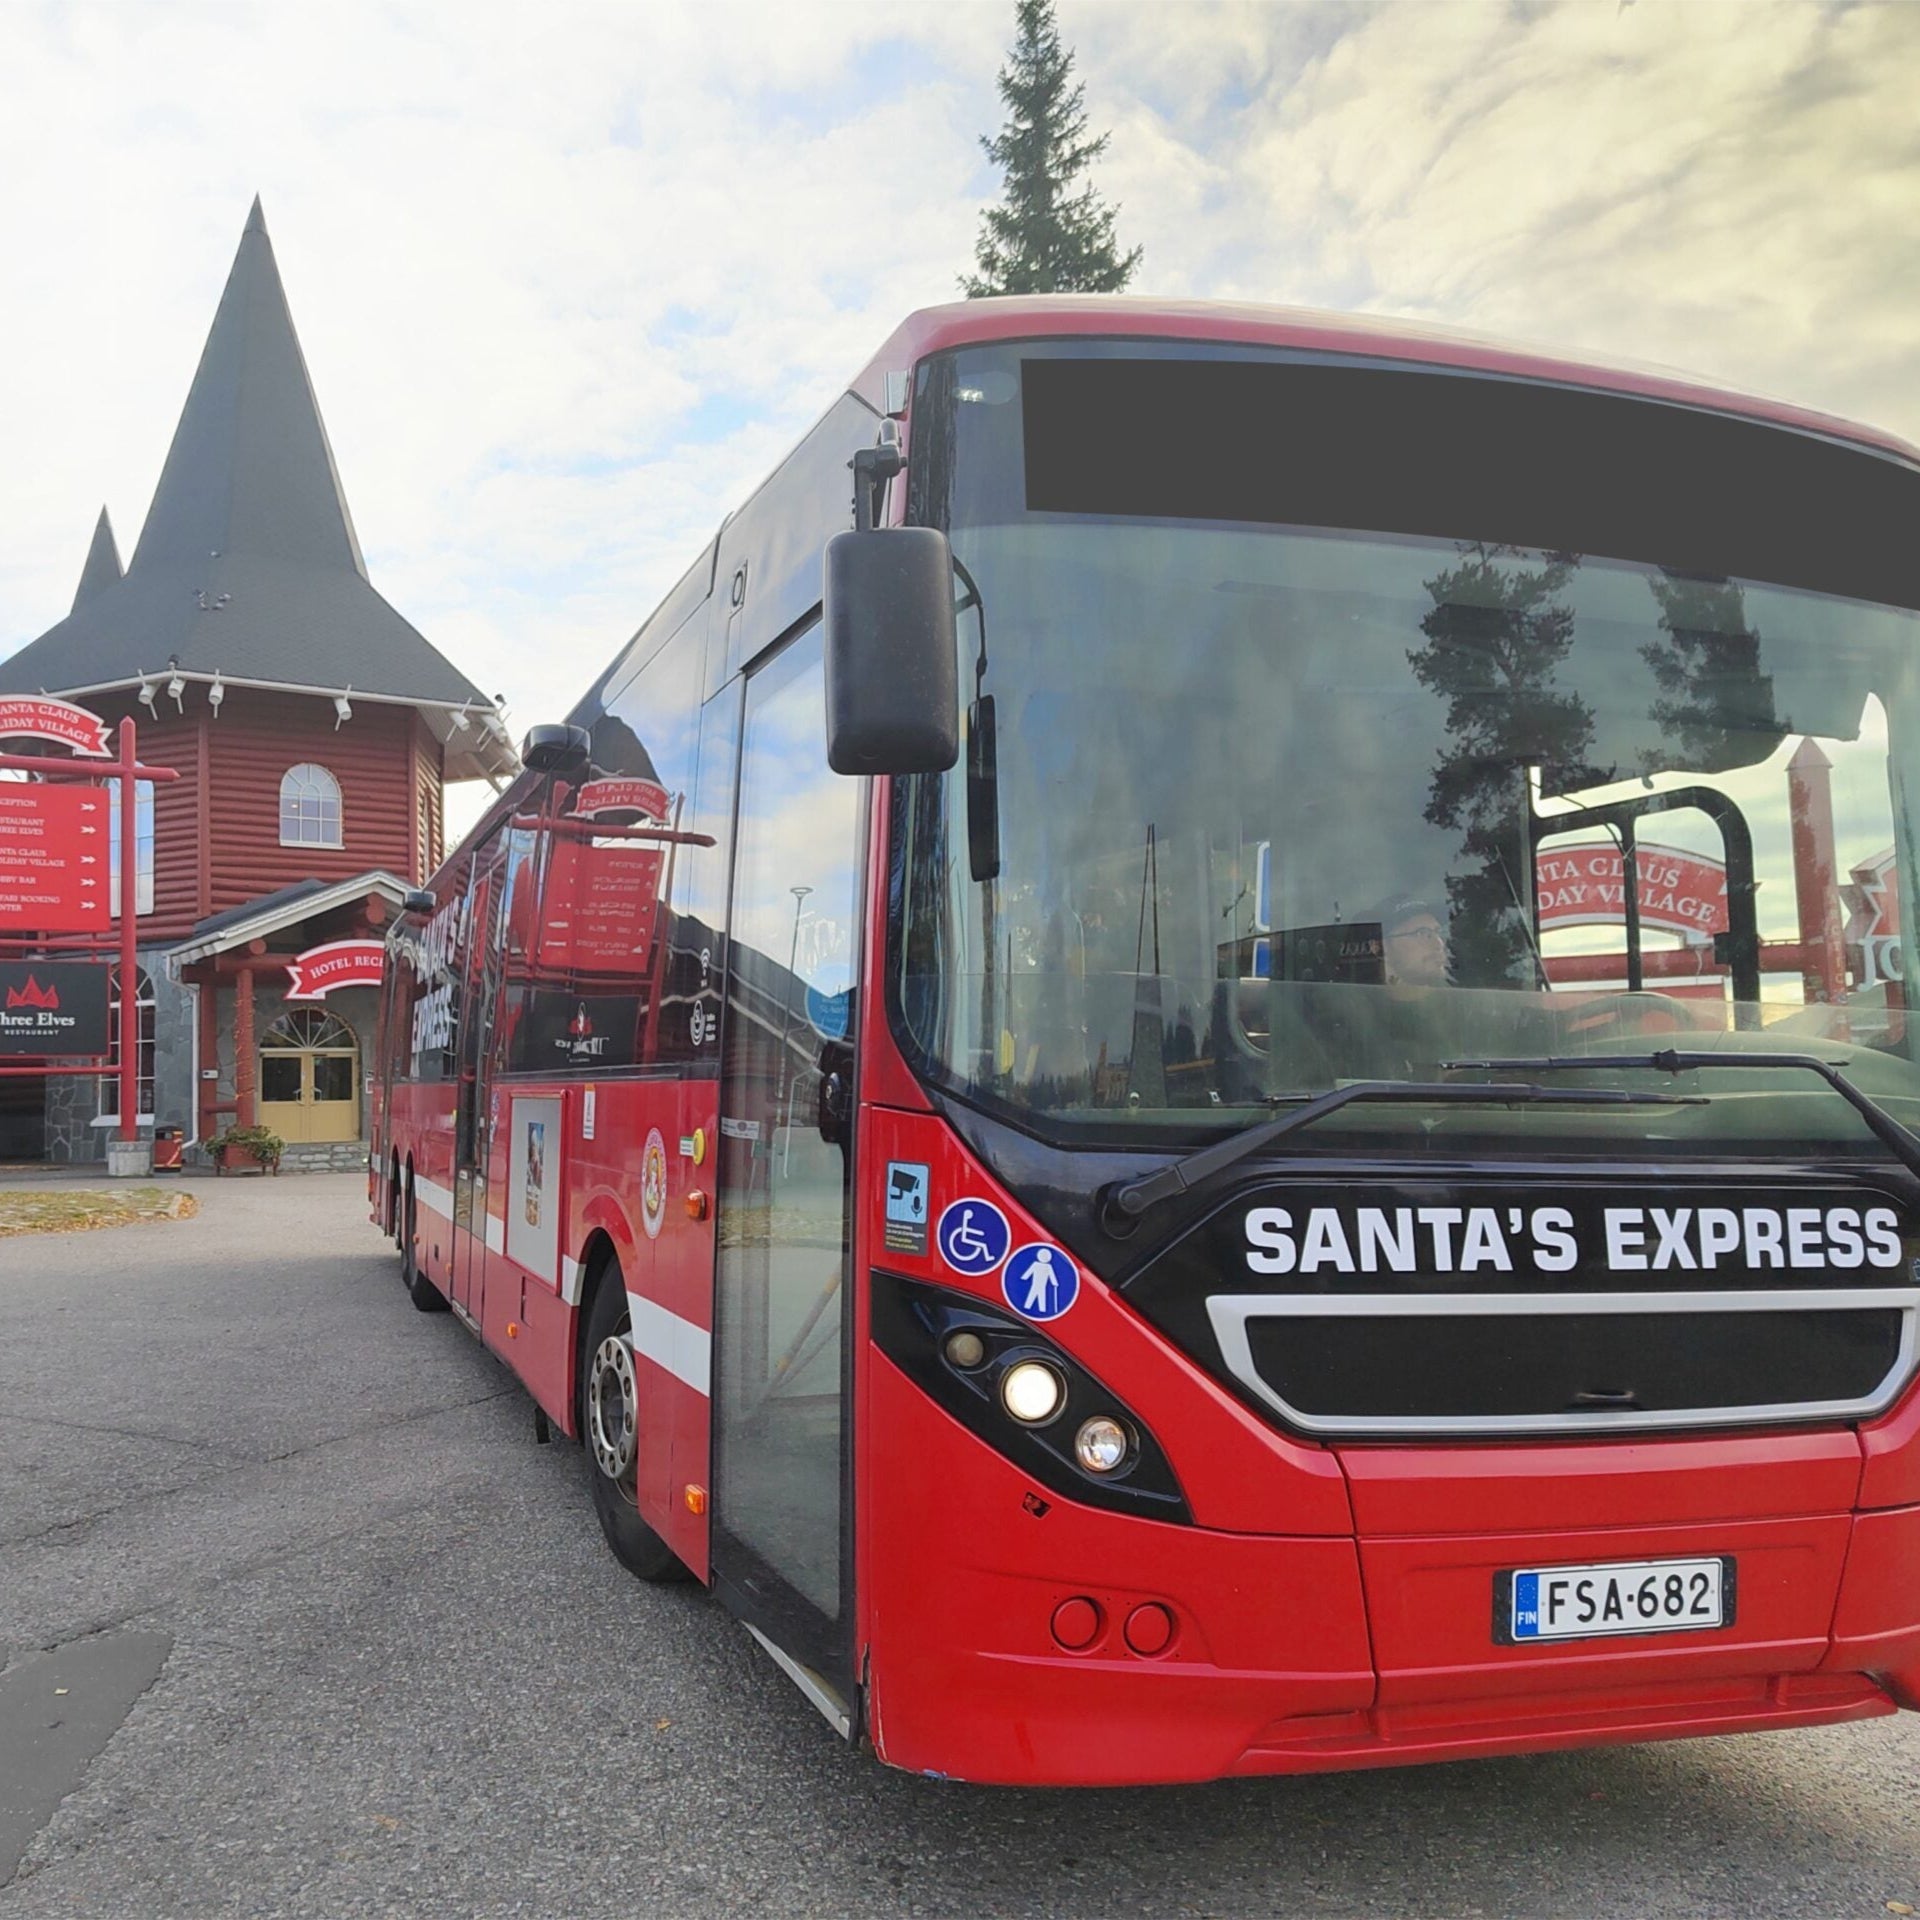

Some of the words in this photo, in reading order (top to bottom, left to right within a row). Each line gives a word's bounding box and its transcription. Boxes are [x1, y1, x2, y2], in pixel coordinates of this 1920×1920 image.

[38, 704, 81, 724] CLAUS
[38, 719, 92, 744] VILLAGE
[18, 848, 47, 857] CLAUS
[29, 858, 65, 867] VILLAGE
[19, 876, 36, 885] BAR
[20, 895, 60, 904] BOOKING
[1597, 884, 1715, 922] VILAGE
[310, 957, 352, 979] HOTEL
[0, 1011, 33, 1026] hree
[36, 1011, 76, 1026] Elves
[1244, 1207, 1578, 1274] SANTA'S
[1603, 1207, 1903, 1270] EXPRESS
[1517, 1610, 1537, 1626] FIN
